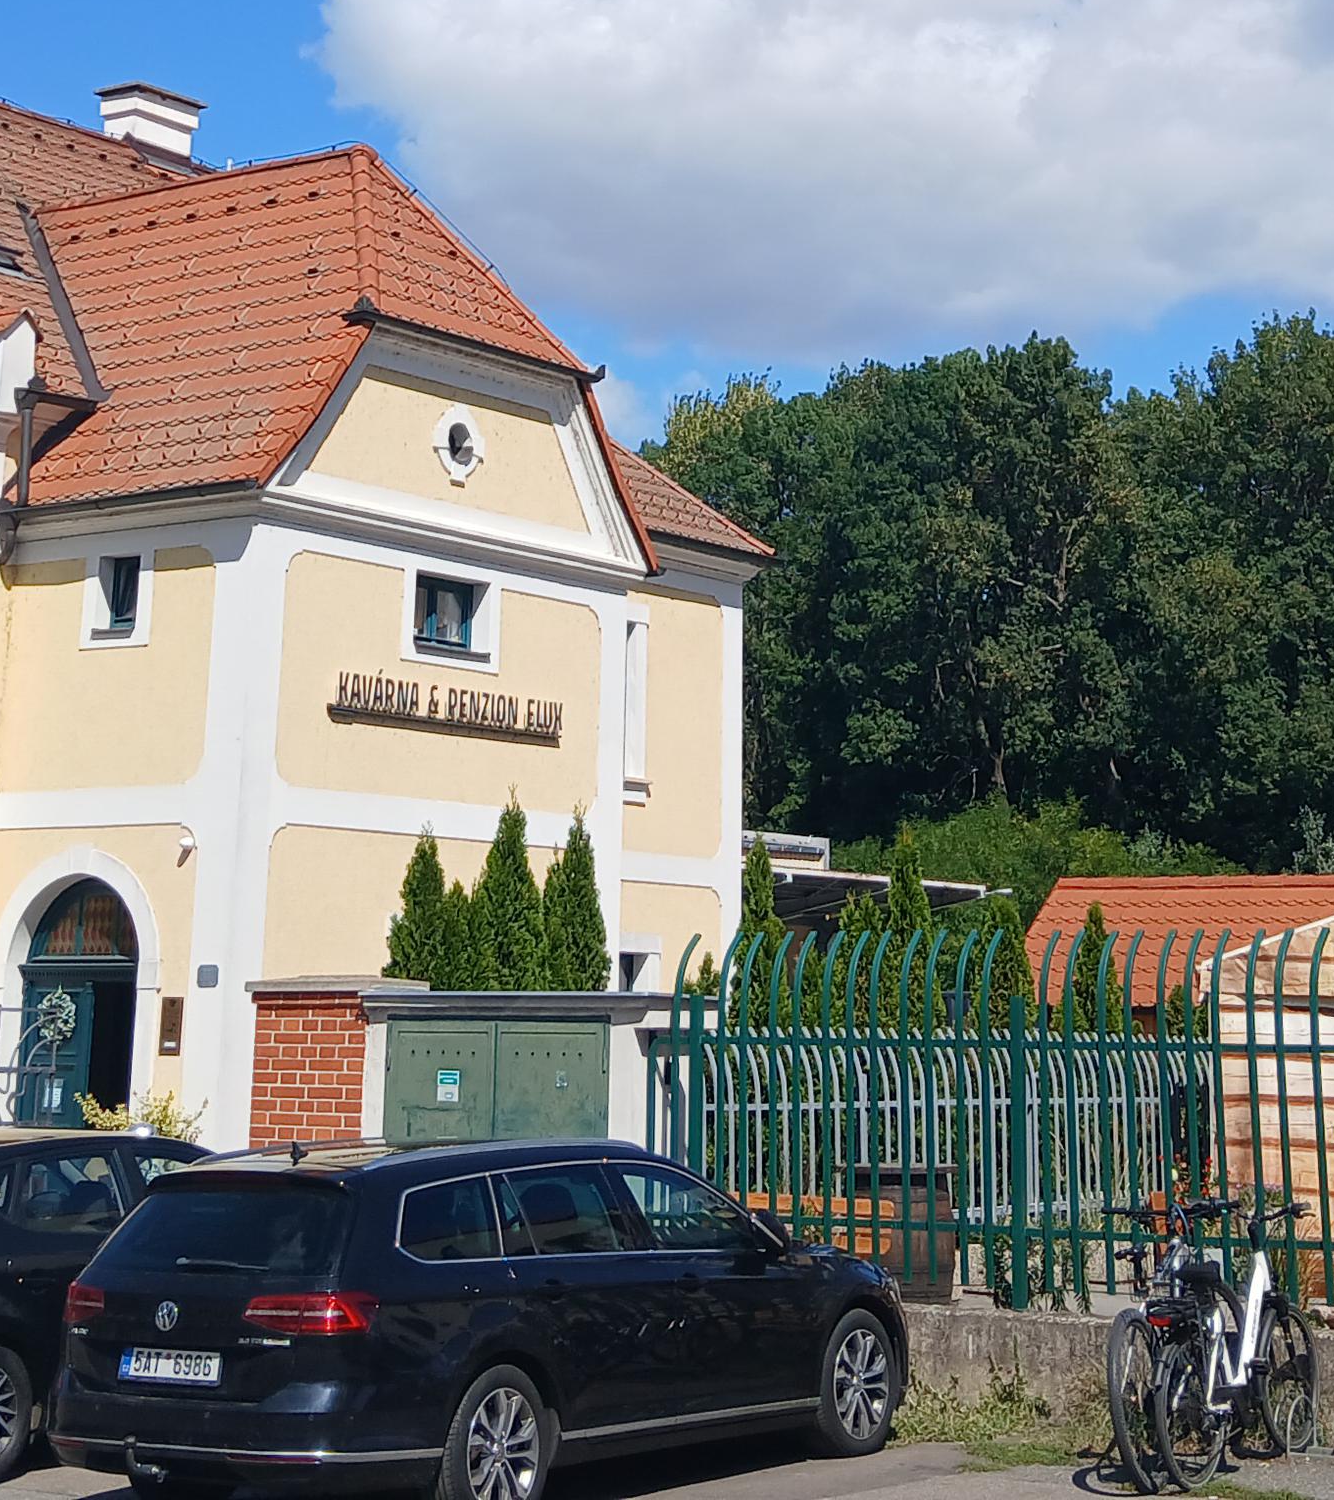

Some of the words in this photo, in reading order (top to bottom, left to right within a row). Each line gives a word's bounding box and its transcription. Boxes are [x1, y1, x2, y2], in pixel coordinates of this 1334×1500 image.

[336, 669, 419, 714] KAVÁRNA
[428, 684, 440, 716] &
[447, 687, 519, 727] PENZION
[527, 699, 563, 733] ELUX
[133, 1350, 160, 1373] 5AT
[173, 1353, 213, 1376] 6986
